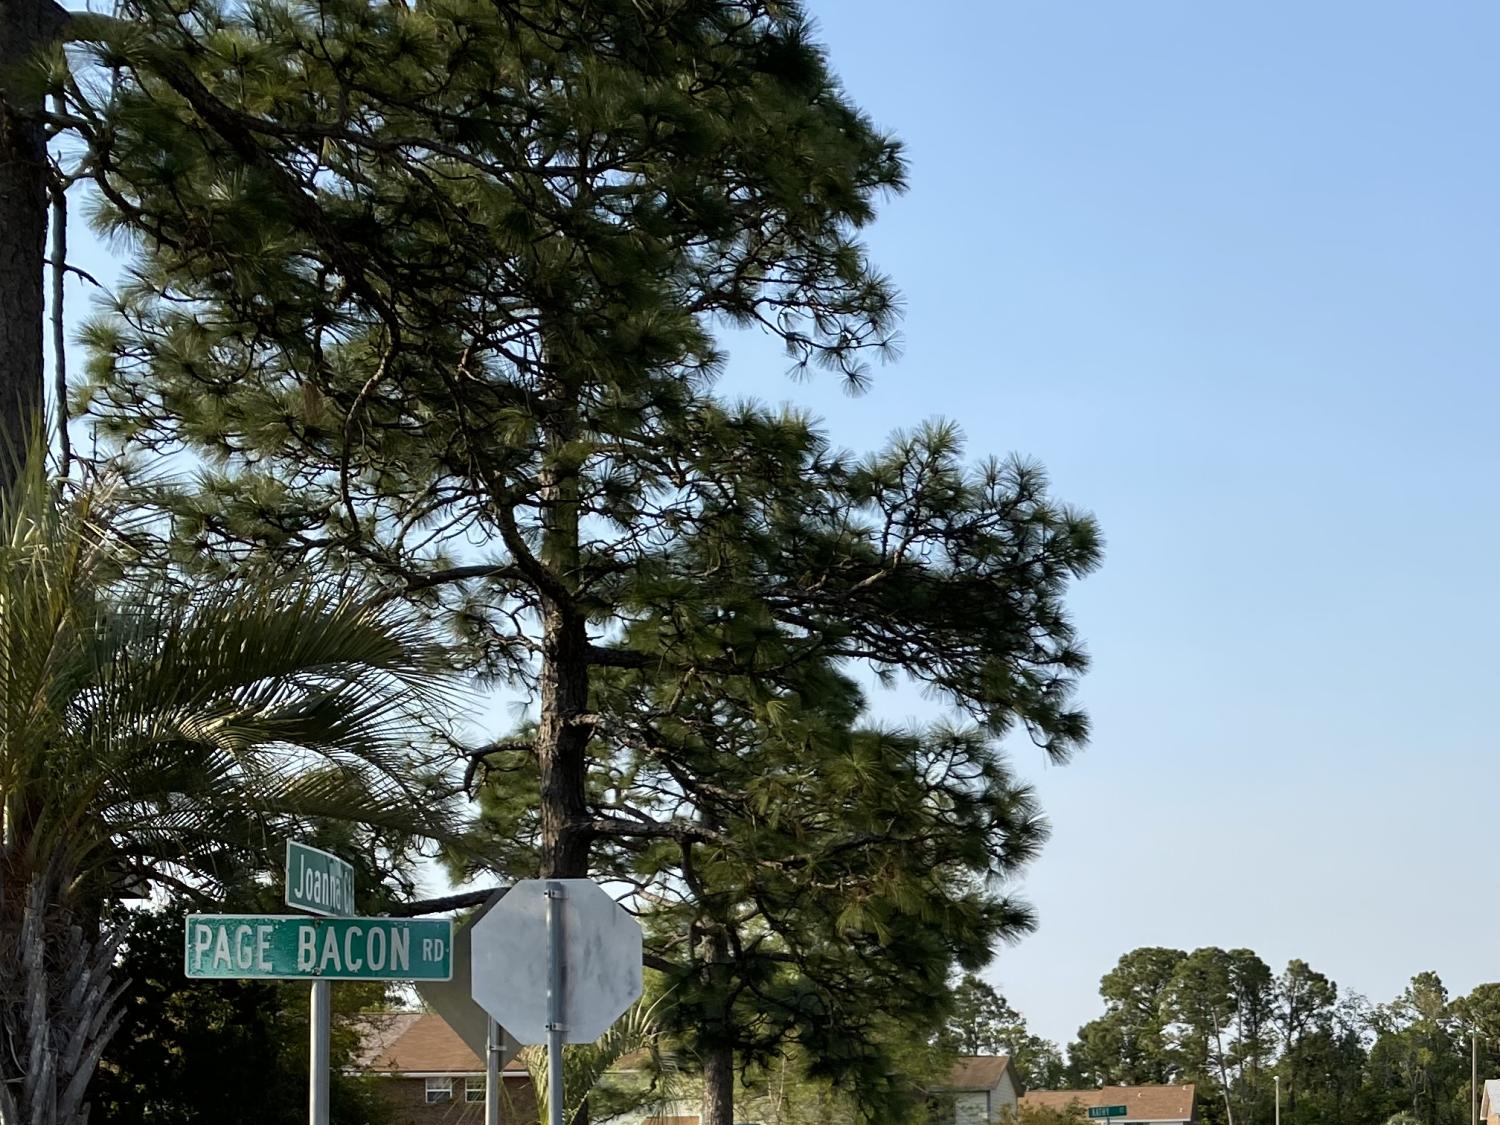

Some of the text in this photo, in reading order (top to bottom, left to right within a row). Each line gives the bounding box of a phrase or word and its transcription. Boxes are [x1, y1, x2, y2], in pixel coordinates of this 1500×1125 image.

[294, 854, 341, 910] Joanna
[194, 923, 444, 973] PAGE BACON RD
